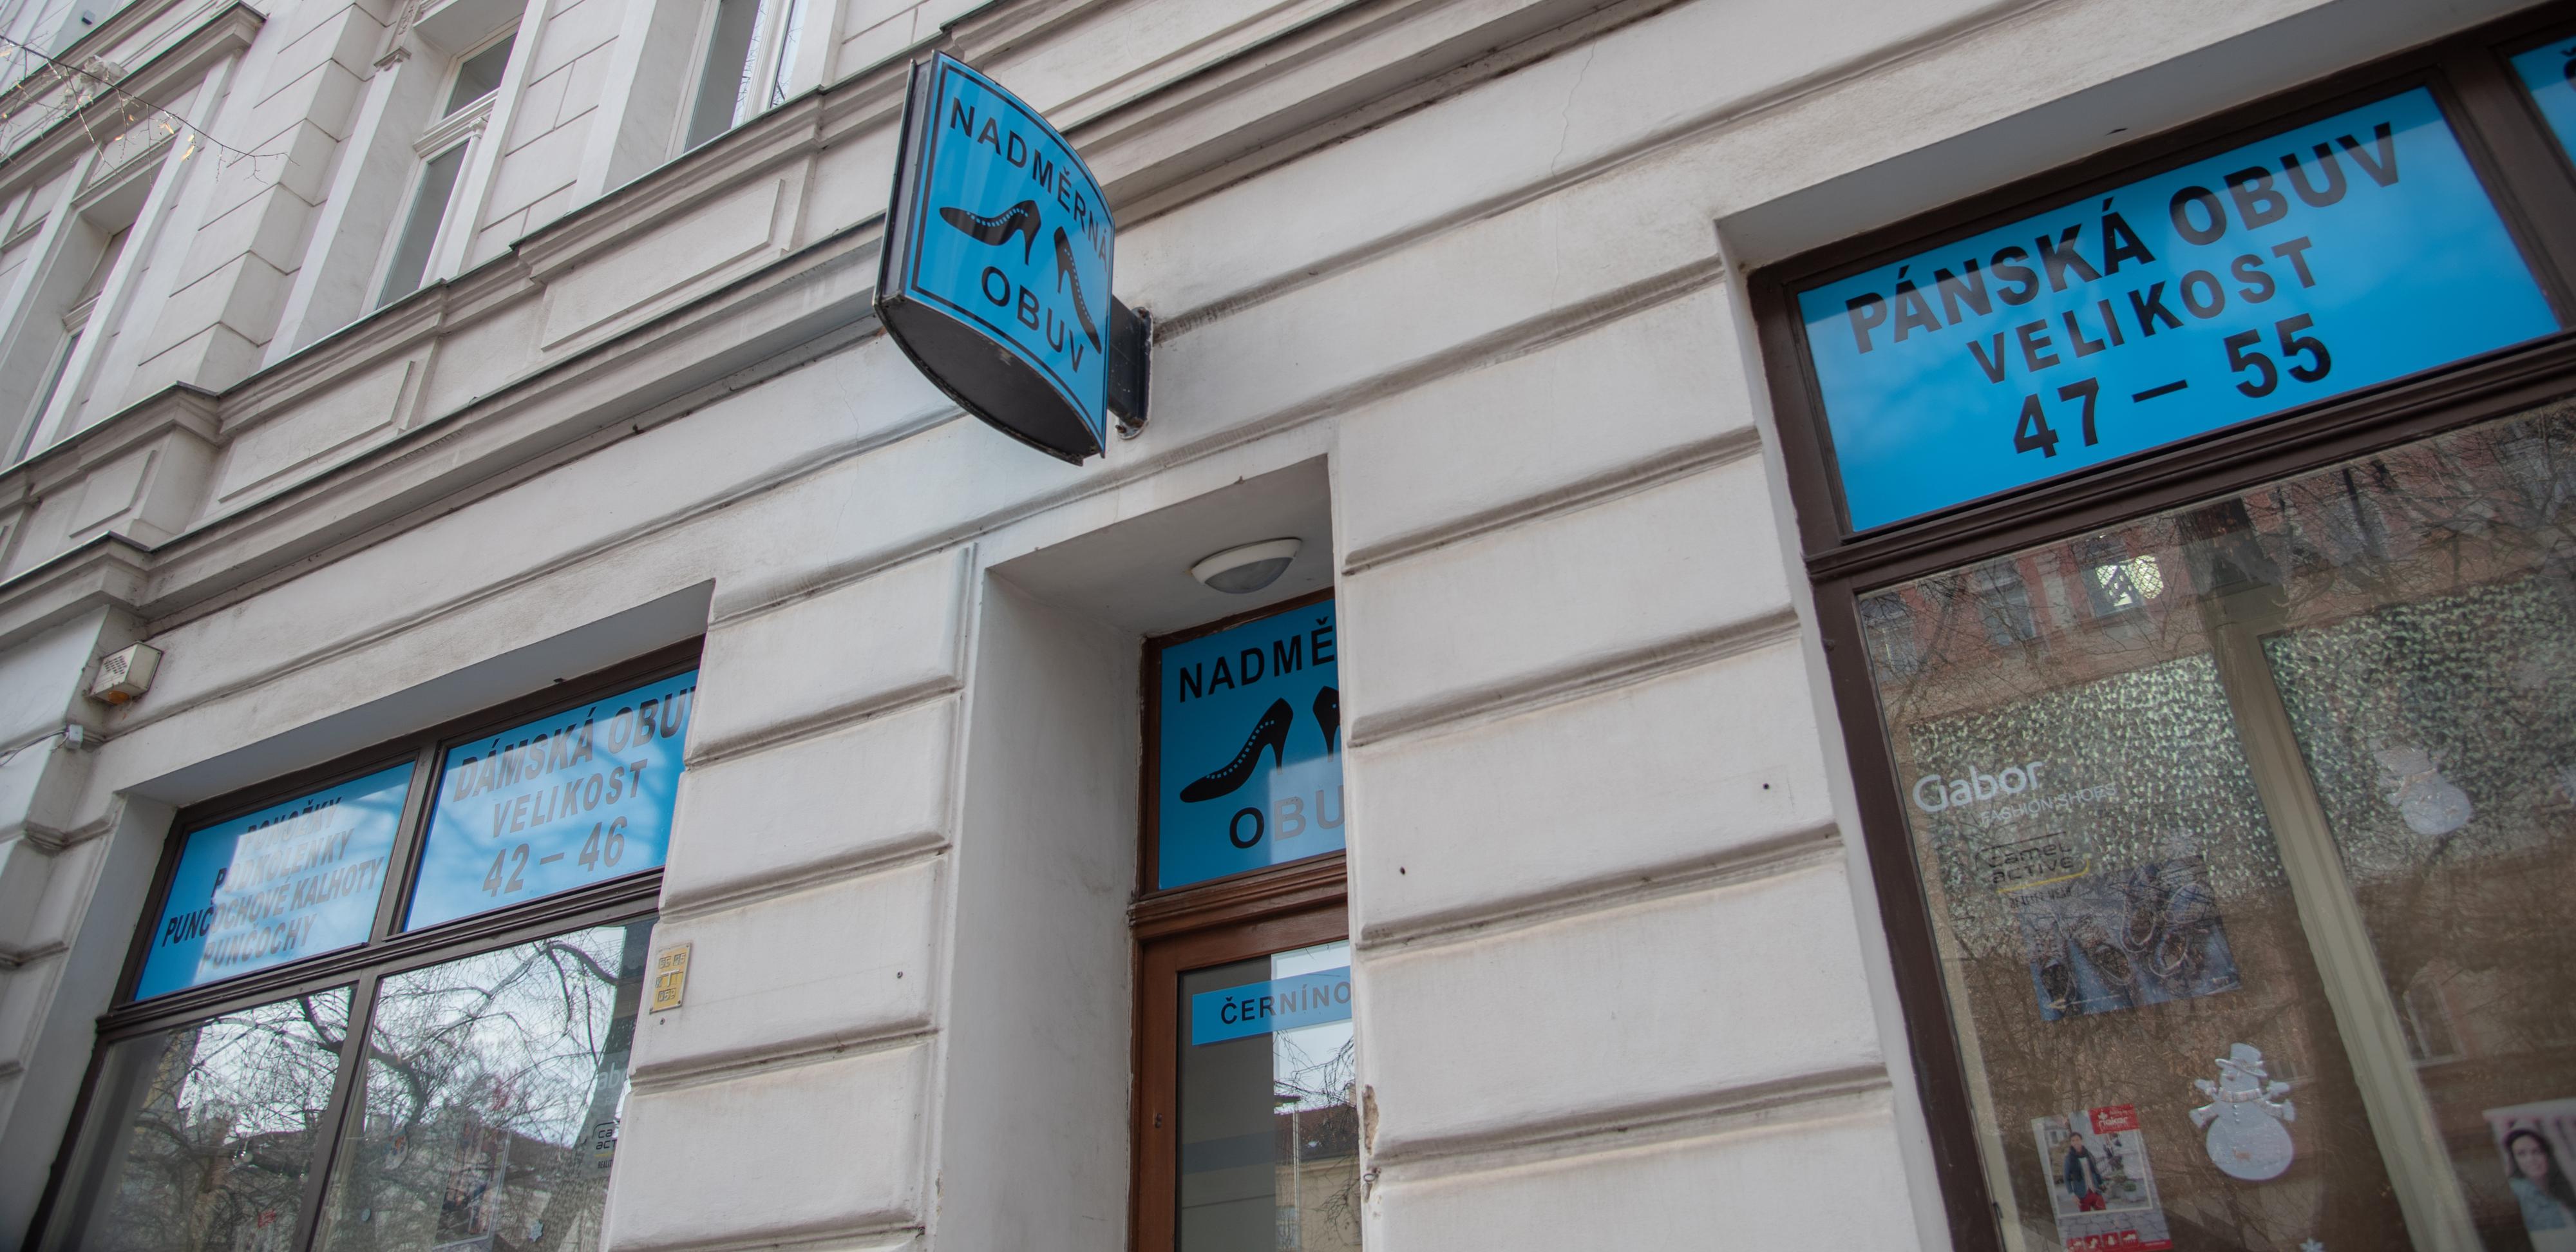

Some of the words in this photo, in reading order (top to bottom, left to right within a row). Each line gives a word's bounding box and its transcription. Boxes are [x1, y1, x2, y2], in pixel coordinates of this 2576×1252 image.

[950, 97, 1107, 273] NADMĚRNÁ
[1844, 196, 2155, 354] PÁNSKÁ
[2168, 122, 2400, 246] OBUV
[981, 266, 1084, 372] OBUV
[1967, 236, 2316, 384] VELIKOST
[2012, 377, 2099, 459] 47
[2222, 313, 2331, 399] 55
[1180, 616, 1335, 703] NADMĚ
[453, 707, 596, 802] DÁMSKÁ
[607, 686, 696, 754] OBU
[493, 759, 648, 838] VELIKOST
[1229, 784, 1344, 849] OBU
[1913, 761, 2044, 813] Gabor
[1980, 797, 2054, 824] FASHION
[2057, 782, 2117, 806] SHOES
[213, 828, 354, 896] PODKOLENKY
[482, 843, 530, 898] 42
[578, 816, 627, 871] 46
[162, 877, 290, 947] PUNČOCHOVÉ
[290, 857, 384, 911] KALHOTY
[199, 913, 317, 973] PUNČOCHY
[1221, 982, 1350, 1024] ČERNÍNO
